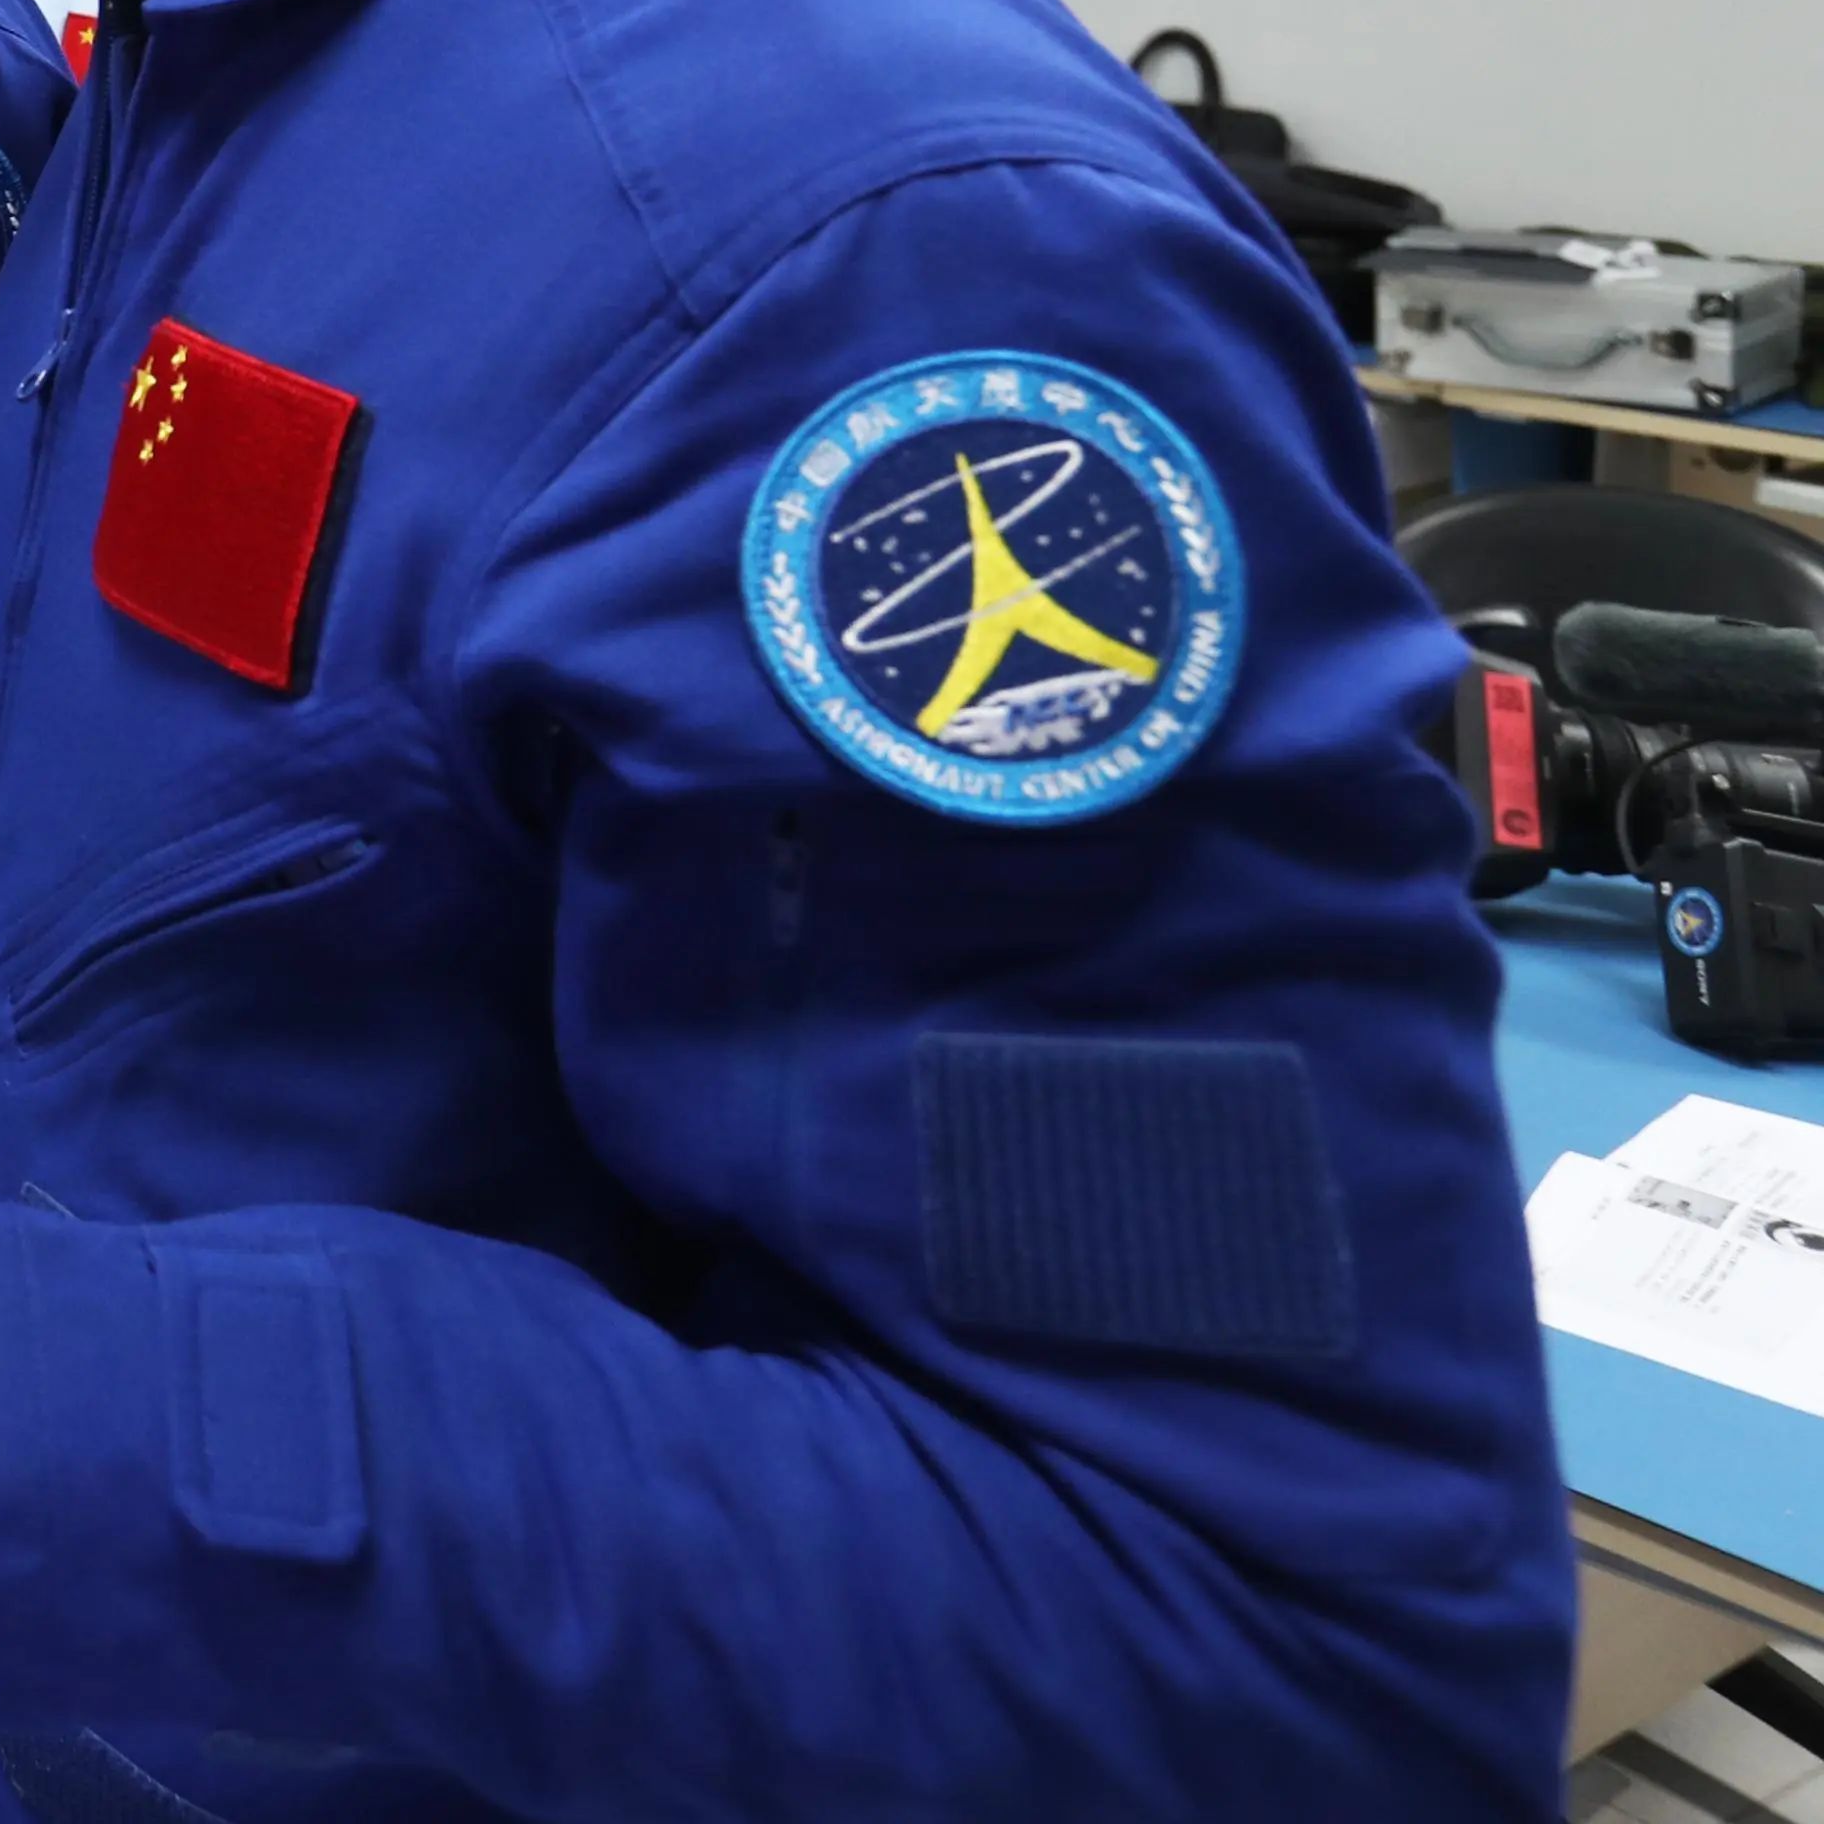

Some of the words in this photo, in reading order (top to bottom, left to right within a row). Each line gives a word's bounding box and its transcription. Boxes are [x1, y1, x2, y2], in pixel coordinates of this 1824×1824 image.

[774, 369, 1148, 531] 中国航天员中心
[818, 696, 1004, 800] ASTRONAUT
[1021, 740, 1143, 800] CENTER
[1174, 610, 1226, 703] CHINA
